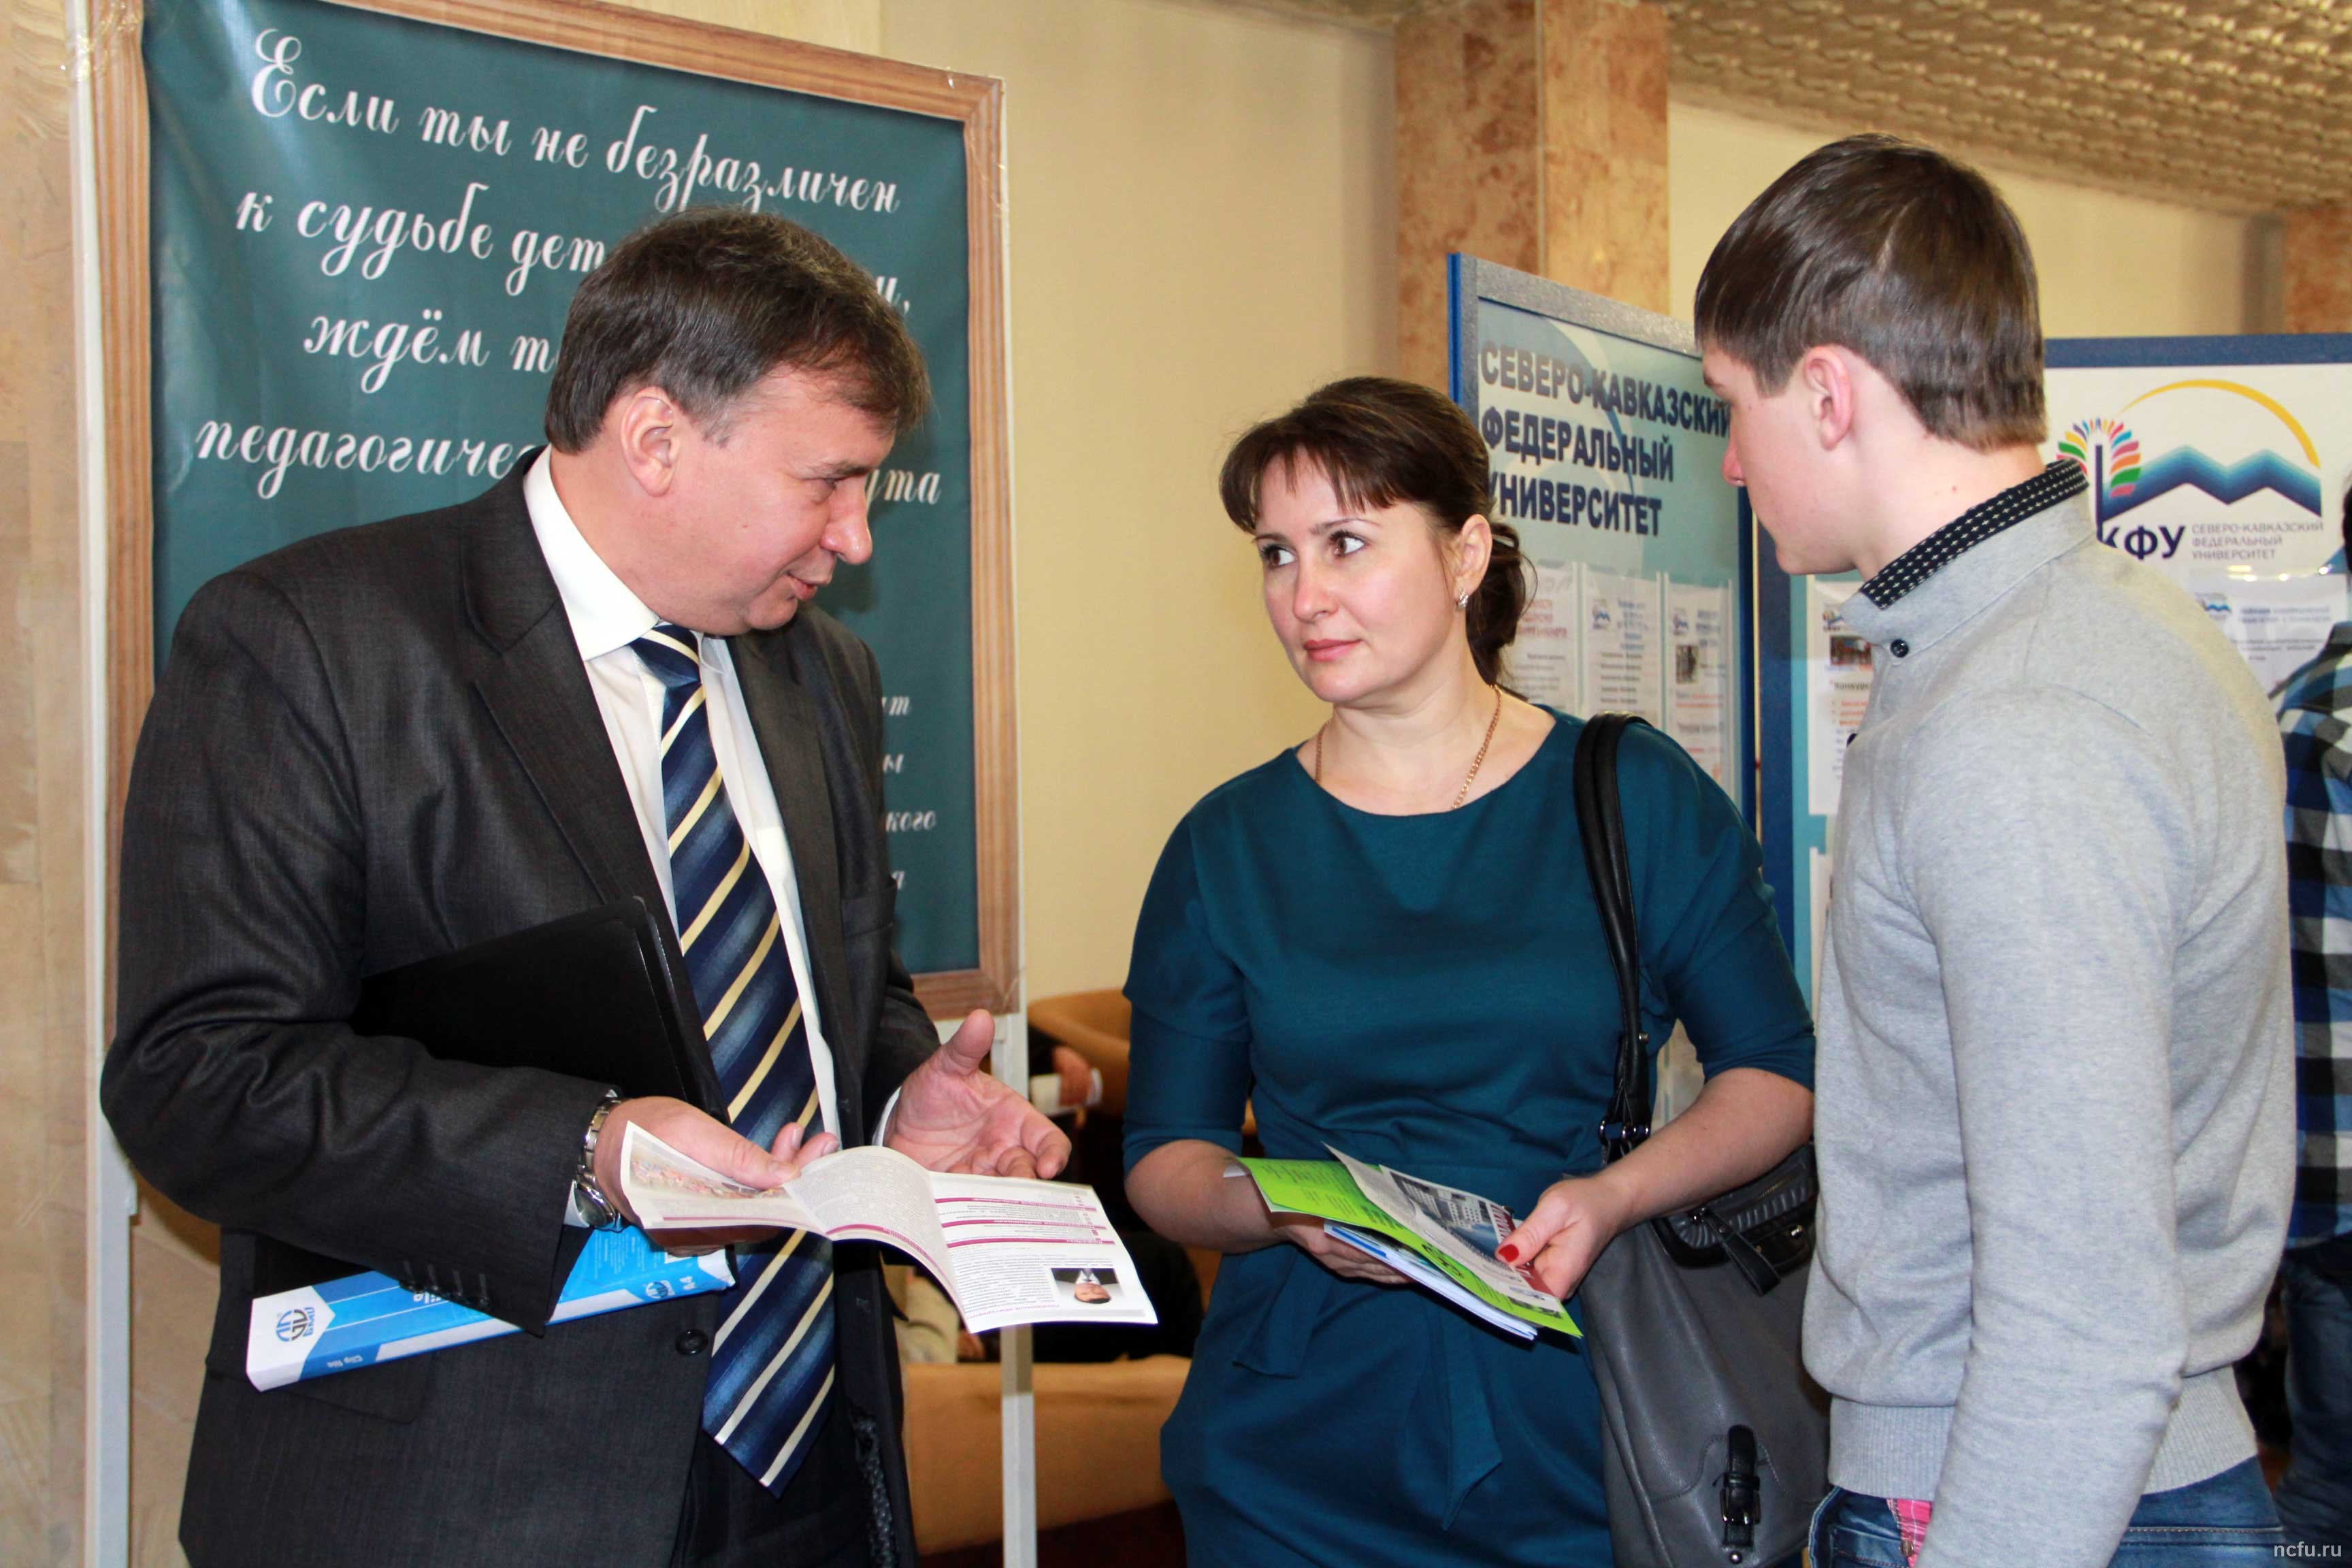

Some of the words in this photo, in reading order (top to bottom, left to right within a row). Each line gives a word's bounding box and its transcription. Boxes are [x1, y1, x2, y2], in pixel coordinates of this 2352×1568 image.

[250, 28, 400, 133] Если
[417, 106, 512, 156] ты
[531, 126, 589, 168] не
[606, 105, 900, 213] безразличен
[233, 192, 274, 232] к
[297, 182, 495, 280] судьбе
[505, 229, 606, 297] дет
[303, 308, 490, 393] ждём
[195, 420, 536, 500] педагогиче
[1481, 406, 1674, 483] ФЕДЕРАЛЬНЫЙ
[2191, 522, 2324, 535] СЕВЕРО-КАВКАЗСКИЙ
[2191, 536, 2283, 547] ФЕДЕРАЛЬНЫЙ
[2191, 549, 2276, 561] УНИВЕРСИТЕТ
